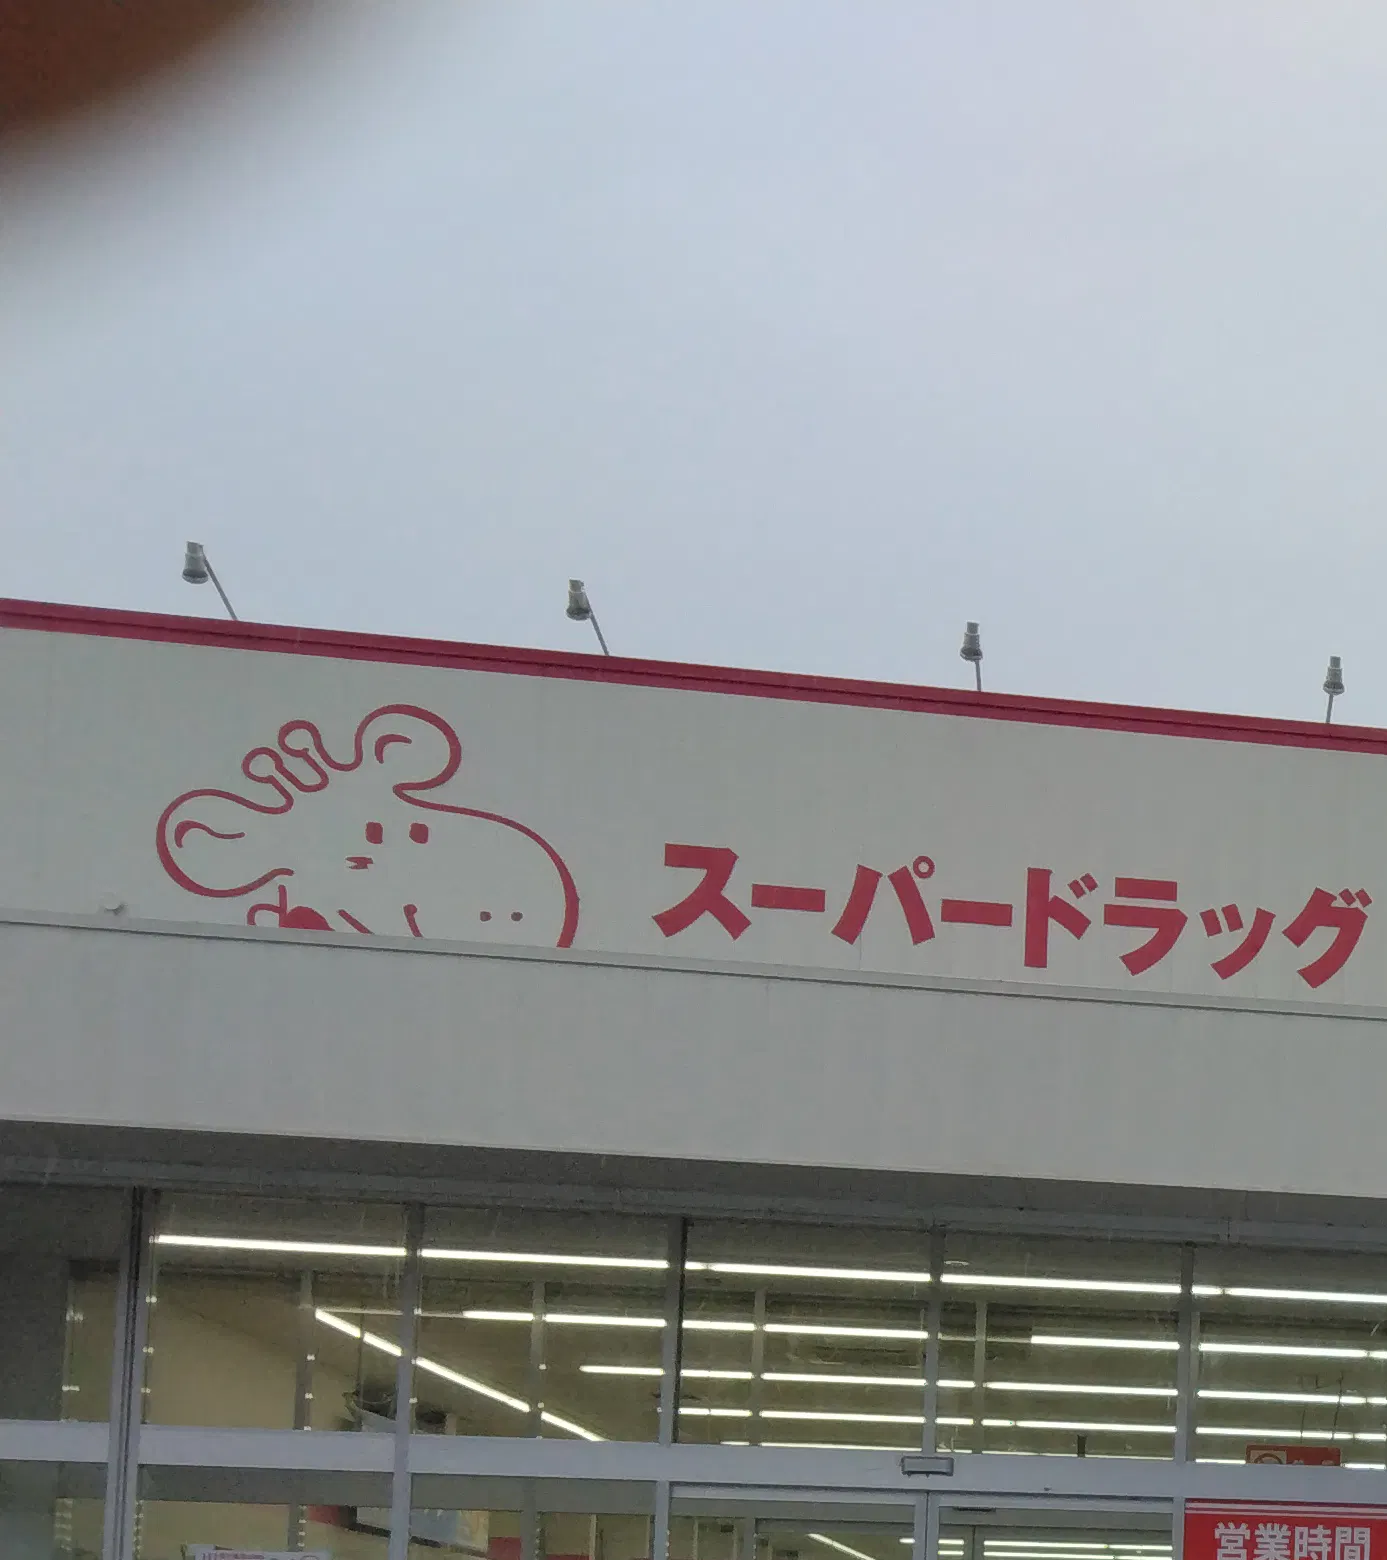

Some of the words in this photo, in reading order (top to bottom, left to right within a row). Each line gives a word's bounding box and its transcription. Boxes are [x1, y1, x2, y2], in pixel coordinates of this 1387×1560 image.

[652, 843, 1372, 988] スーパードラッグ
